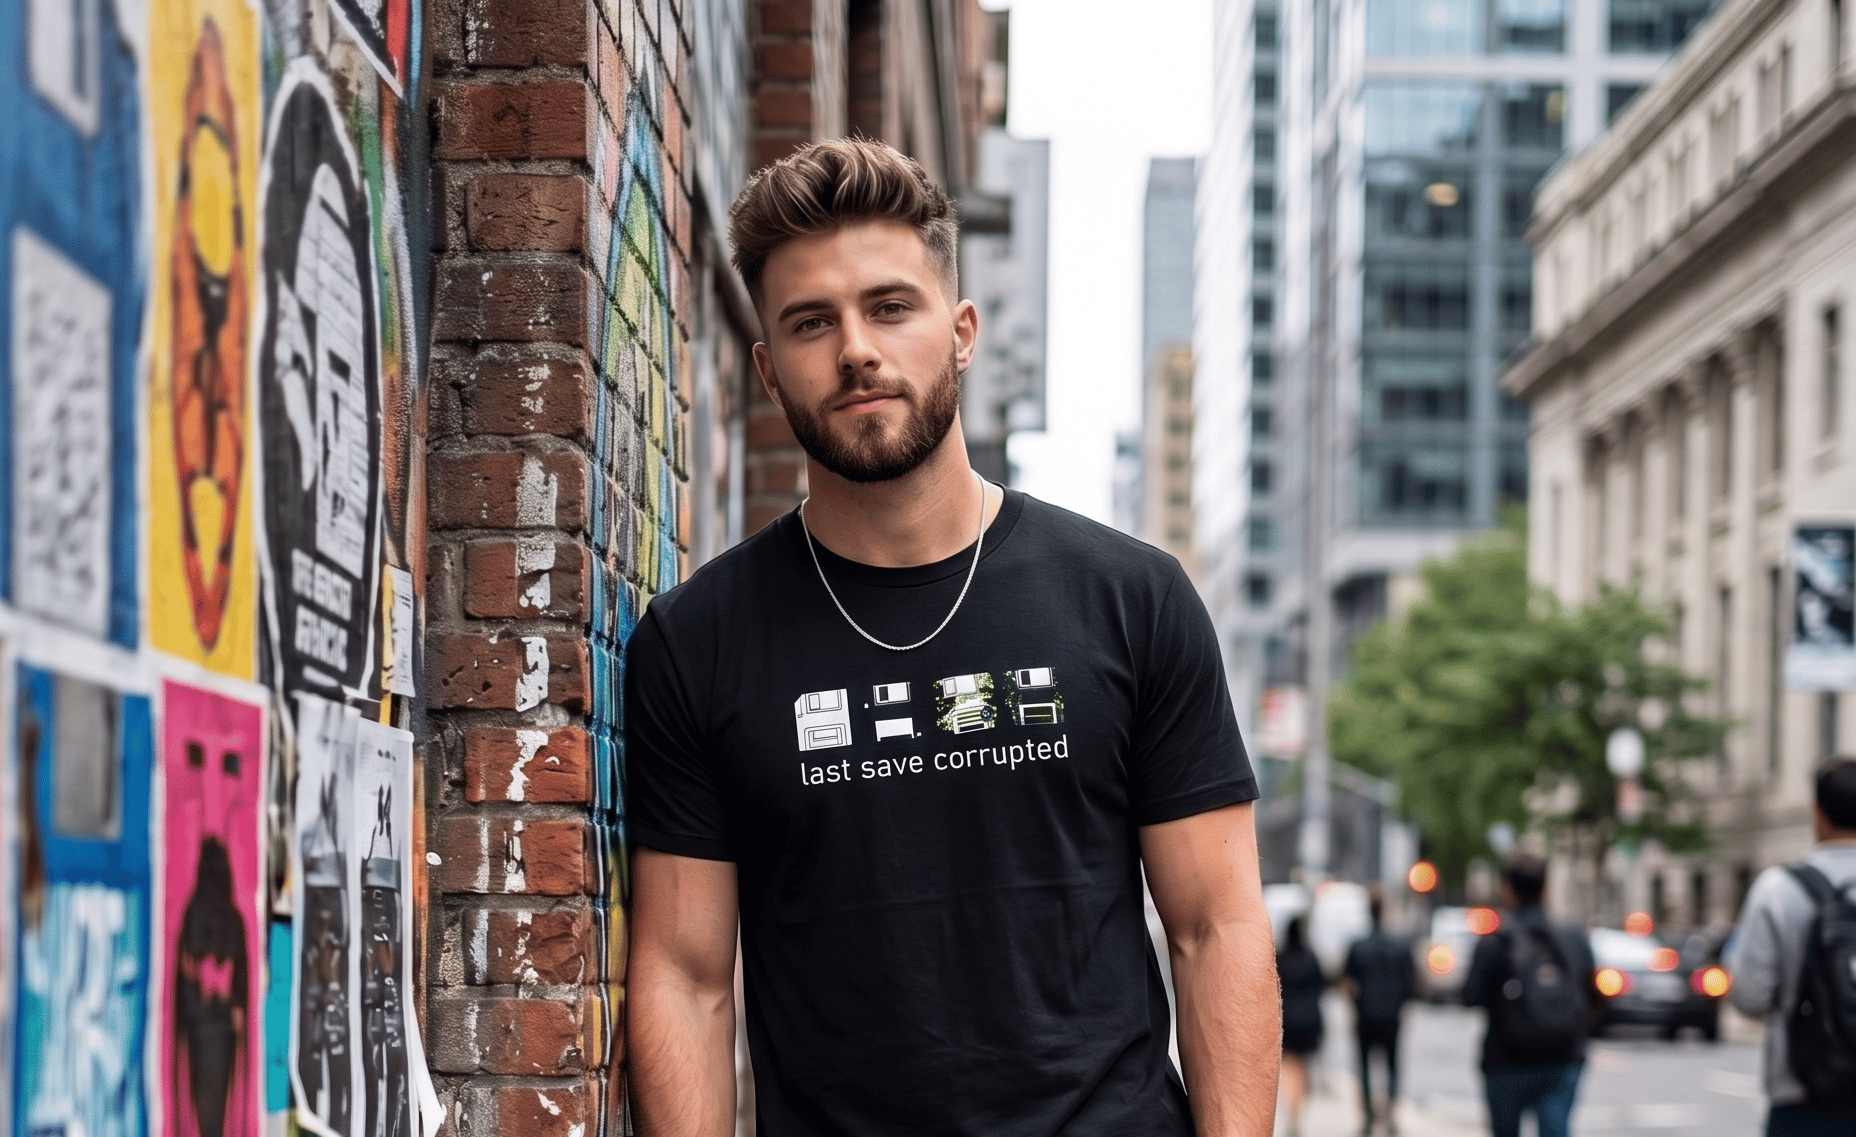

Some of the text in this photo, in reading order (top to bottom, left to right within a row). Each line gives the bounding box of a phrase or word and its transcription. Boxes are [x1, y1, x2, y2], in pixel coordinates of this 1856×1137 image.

[800, 734, 1069, 786] last save corrupted
